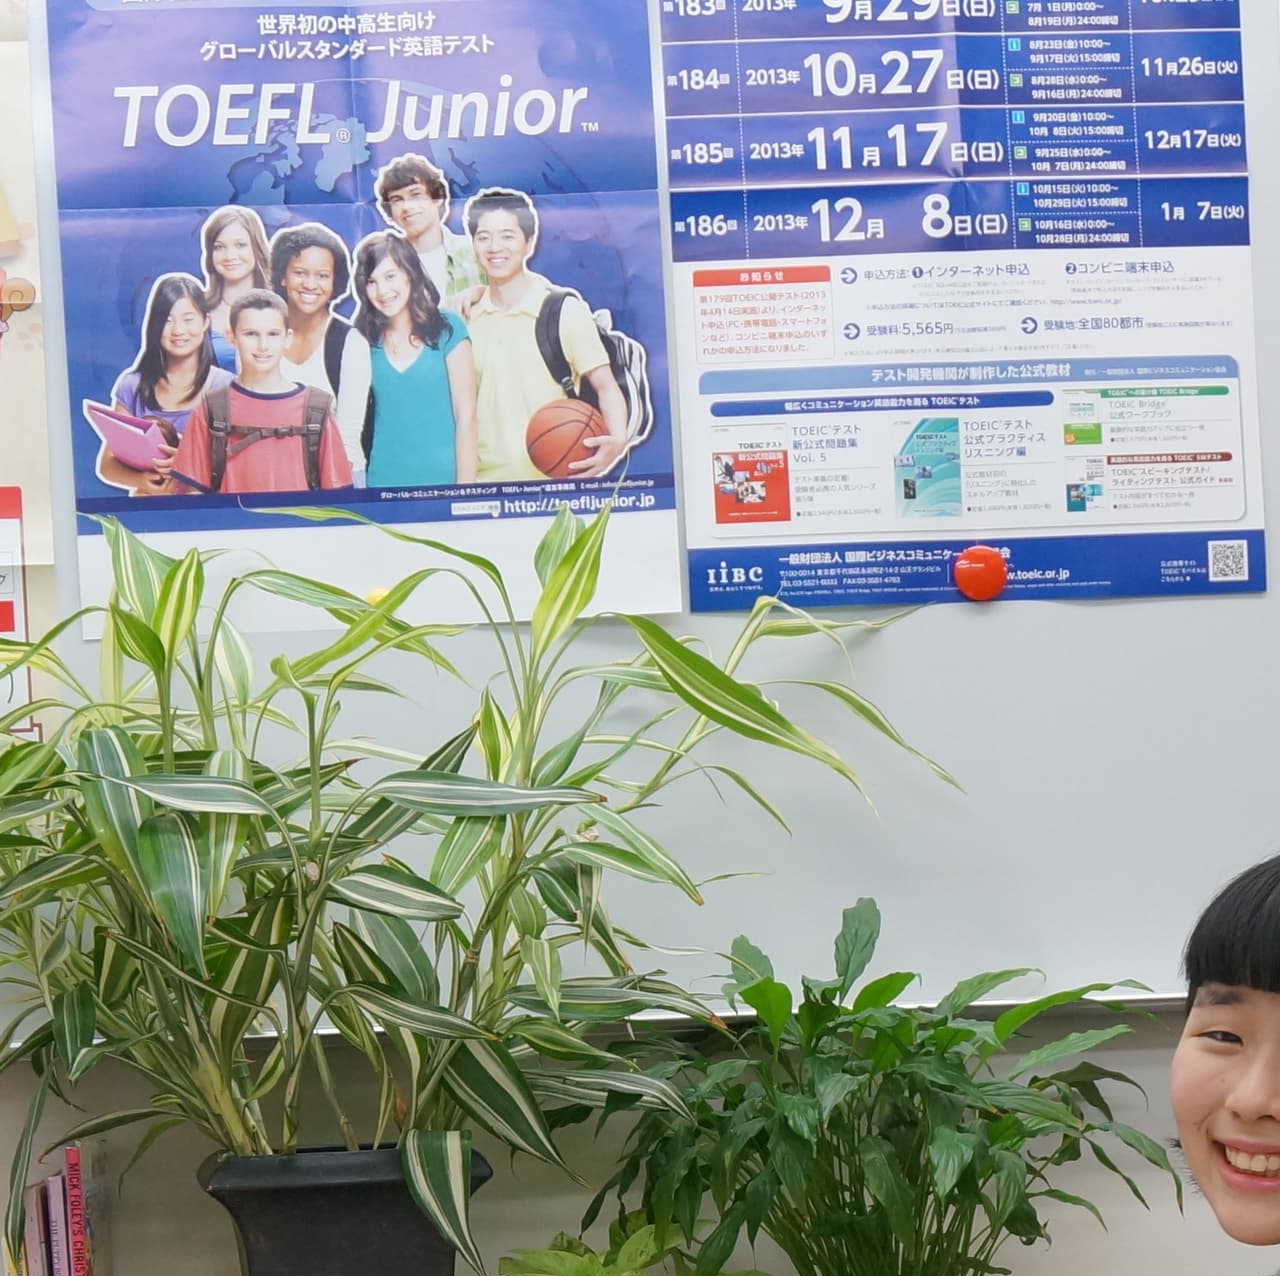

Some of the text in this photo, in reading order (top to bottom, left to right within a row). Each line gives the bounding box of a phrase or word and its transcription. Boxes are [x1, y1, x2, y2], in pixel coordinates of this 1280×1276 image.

[257, 11, 436, 36] 世界初の中高生向け
[199, 35, 495, 62] グローバルスタンダード英語テスト
[1140, 56, 1238, 77] 11月26日(火)
[364, 74, 588, 144] Junior
[1144, 129, 1242, 150] 12月17日(火)
[739, 270, 785, 283] お知らせ
[68, 1162, 81, 1191] MICK
[70, 1194, 84, 1236] FOLEY'S
